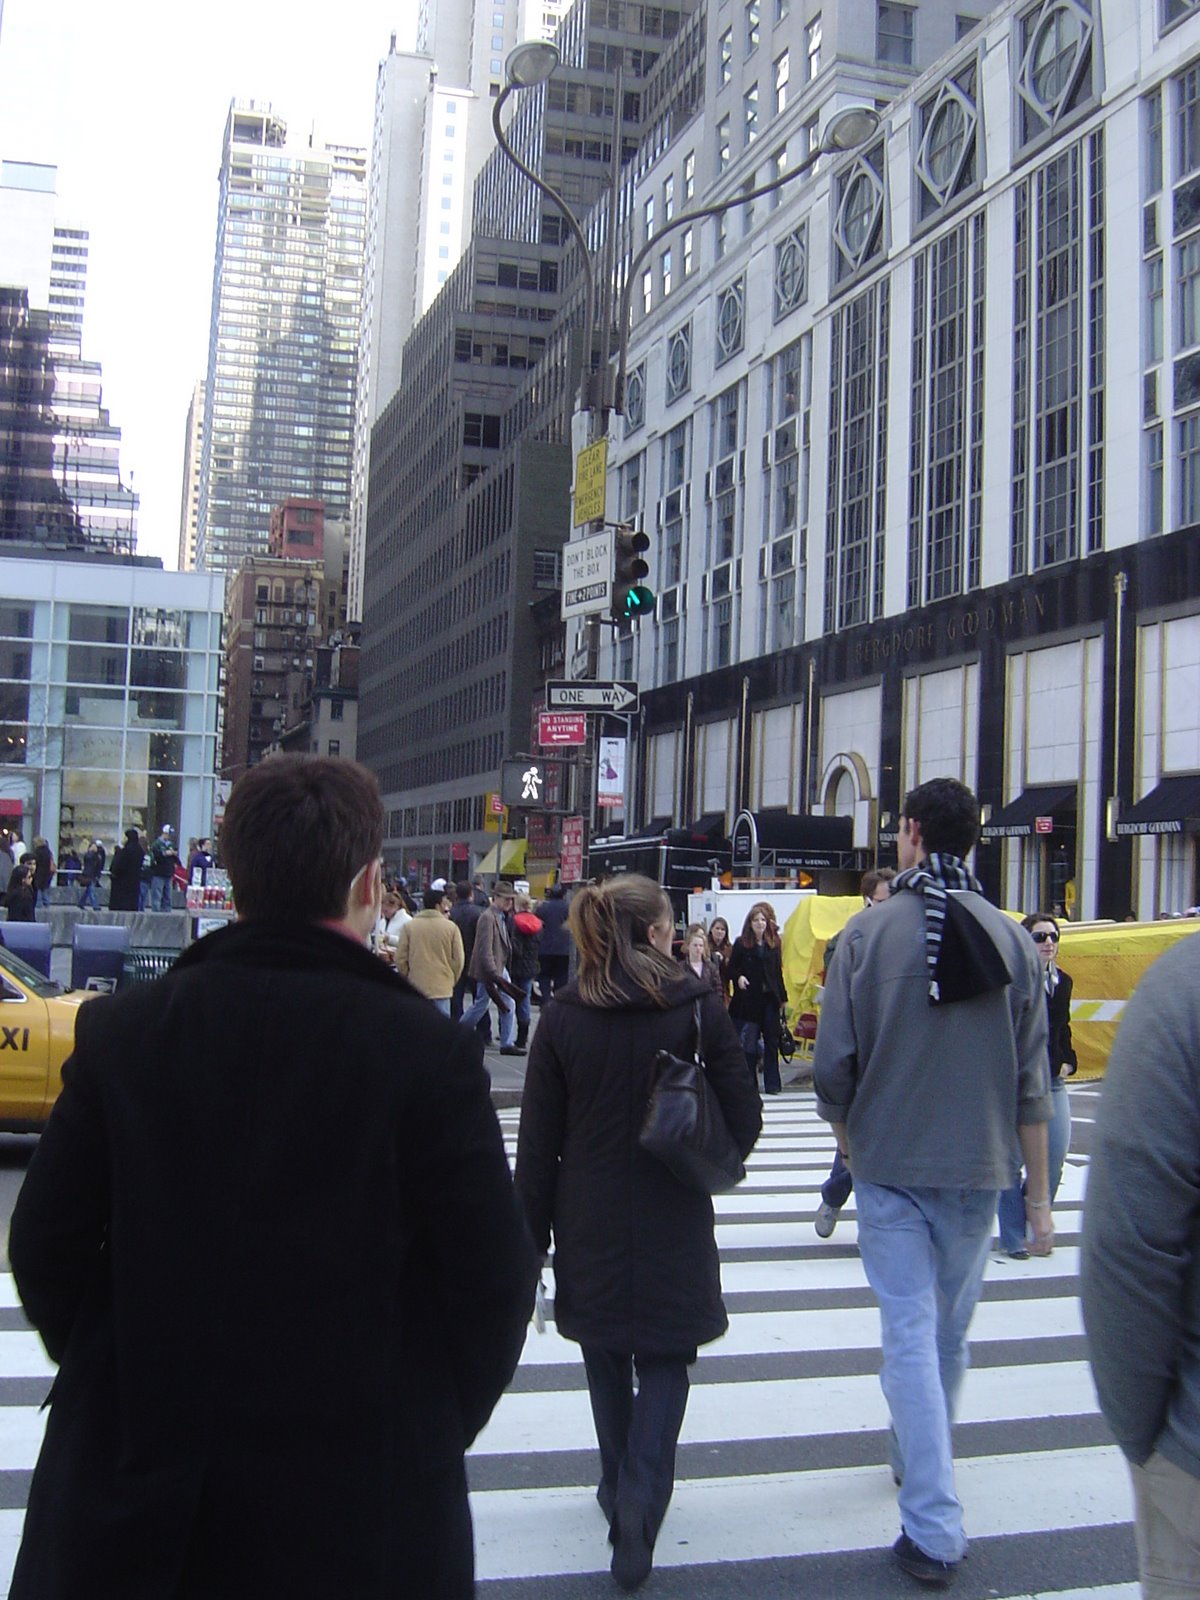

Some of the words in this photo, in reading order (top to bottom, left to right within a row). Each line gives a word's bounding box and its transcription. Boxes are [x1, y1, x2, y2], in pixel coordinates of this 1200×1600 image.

[566, 551, 584, 567] DON'T
[587, 544, 608, 561] BLOCK
[573, 566, 584, 579] THE
[587, 562, 600, 576] BOX
[855, 623, 934, 663] BERGDORF
[946, 594, 1046, 641] GOODMAN
[559, 690, 585, 702] ONE
[601, 690, 627, 702] WAY
[541, 715, 551, 723] NO
[553, 715, 584, 723] STANDING
[546, 724, 578, 732] ANYTIME
[1117, 823, 1148, 835] BERGDORF
[1148, 820, 1181, 833] GOODMAN
